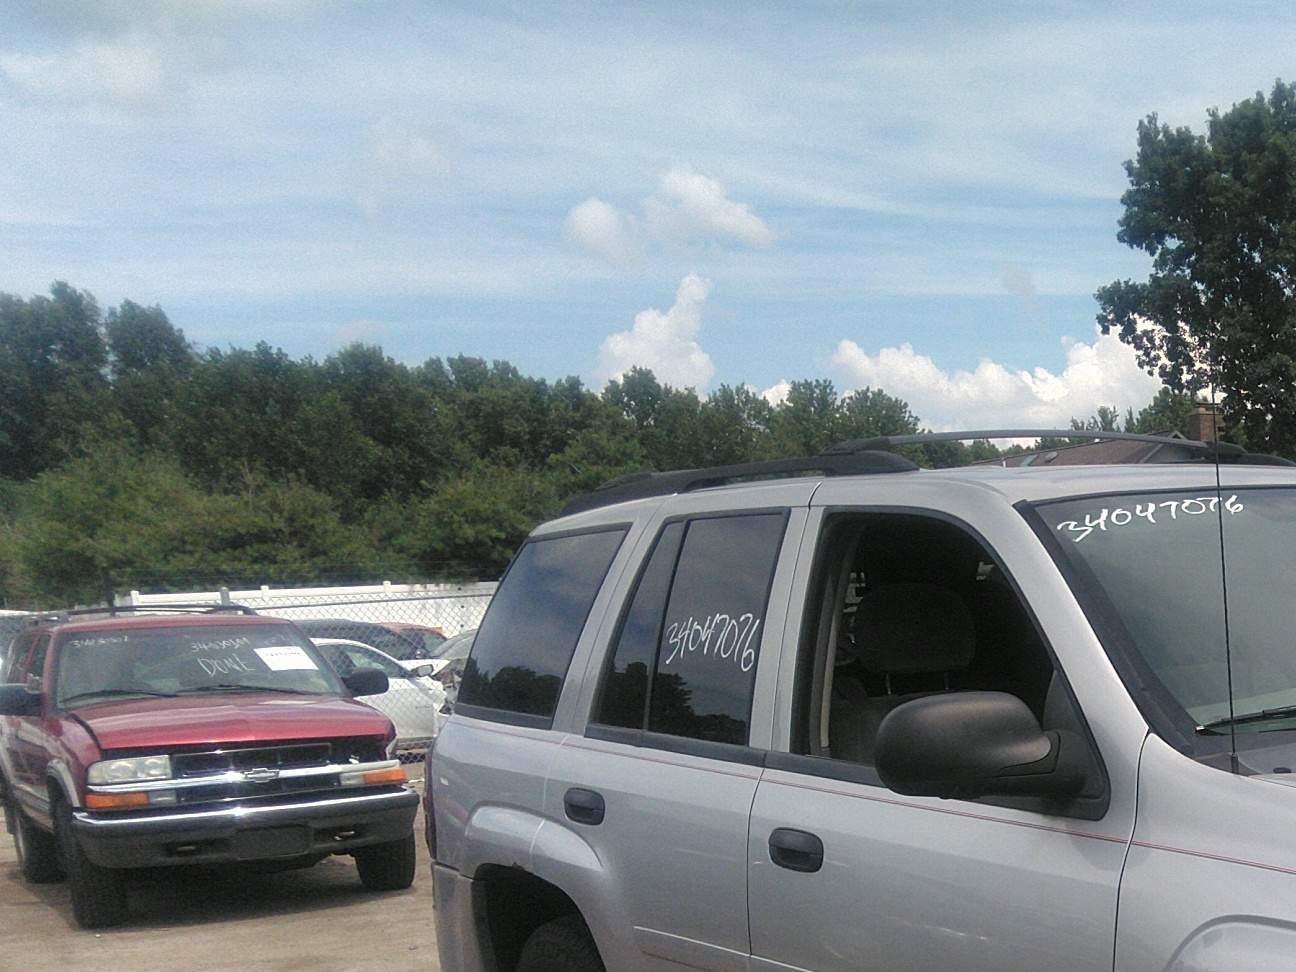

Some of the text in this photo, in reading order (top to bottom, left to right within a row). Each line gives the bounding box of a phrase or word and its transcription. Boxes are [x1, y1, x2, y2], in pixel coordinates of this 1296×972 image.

[1056, 494, 1244, 543] 34047076
[197, 652, 257, 678] DONE
[665, 612, 760, 672] 34047076
